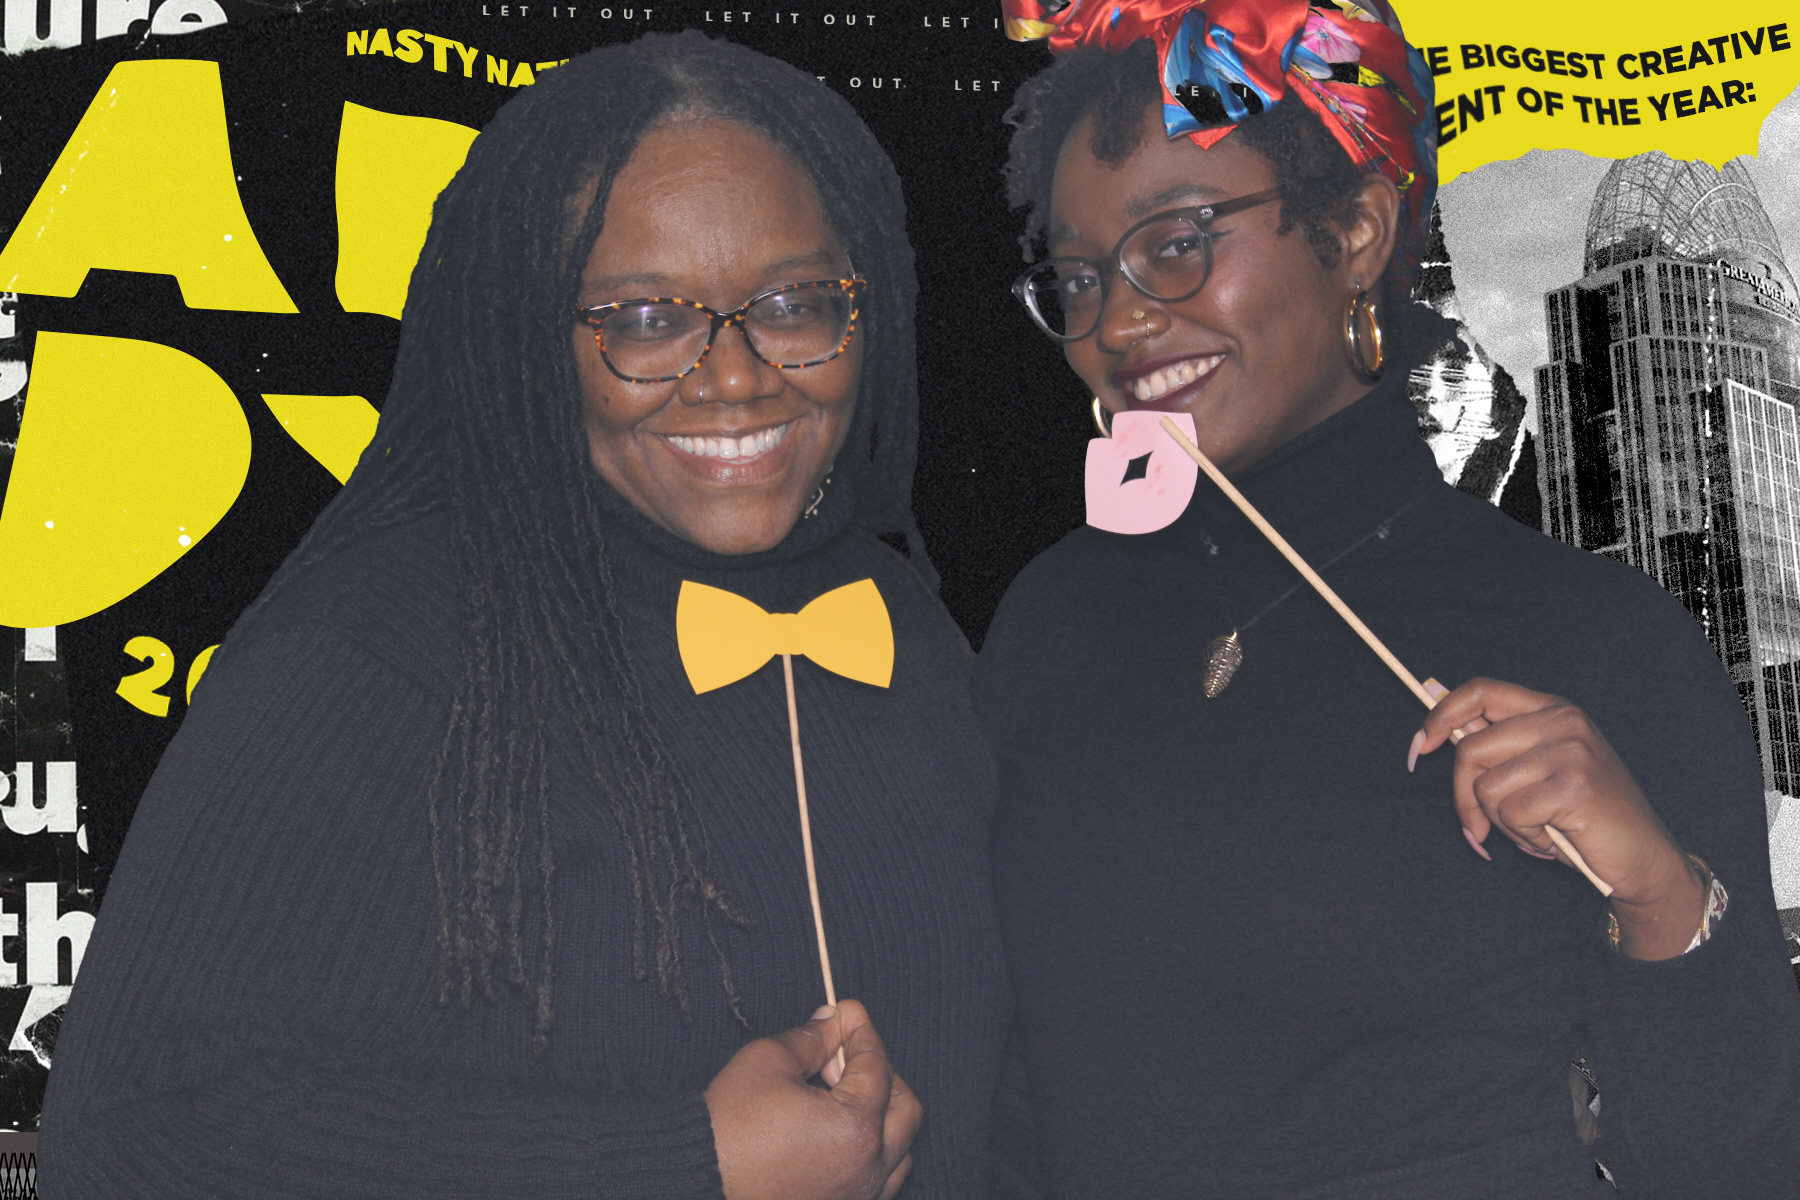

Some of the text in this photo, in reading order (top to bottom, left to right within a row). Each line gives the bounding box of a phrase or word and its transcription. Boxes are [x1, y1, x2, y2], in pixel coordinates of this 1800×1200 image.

[482, 4, 529, 17] LET
[553, 6, 577, 18] IT
[600, 8, 653, 20] OUT
[705, 10, 752, 23] LET
[776, 12, 800, 24] IT
[823, 13, 876, 26] OUT
[924, 16, 970, 28] LET
[346, 28, 479, 78] NASTY
[1460, 43, 1606, 80] BIGGEST
[1616, 22, 1792, 80] CREATIVE
[954, 79, 1001, 92] LET
[1434, 80, 1757, 148] ENT OF THE YEAR:
